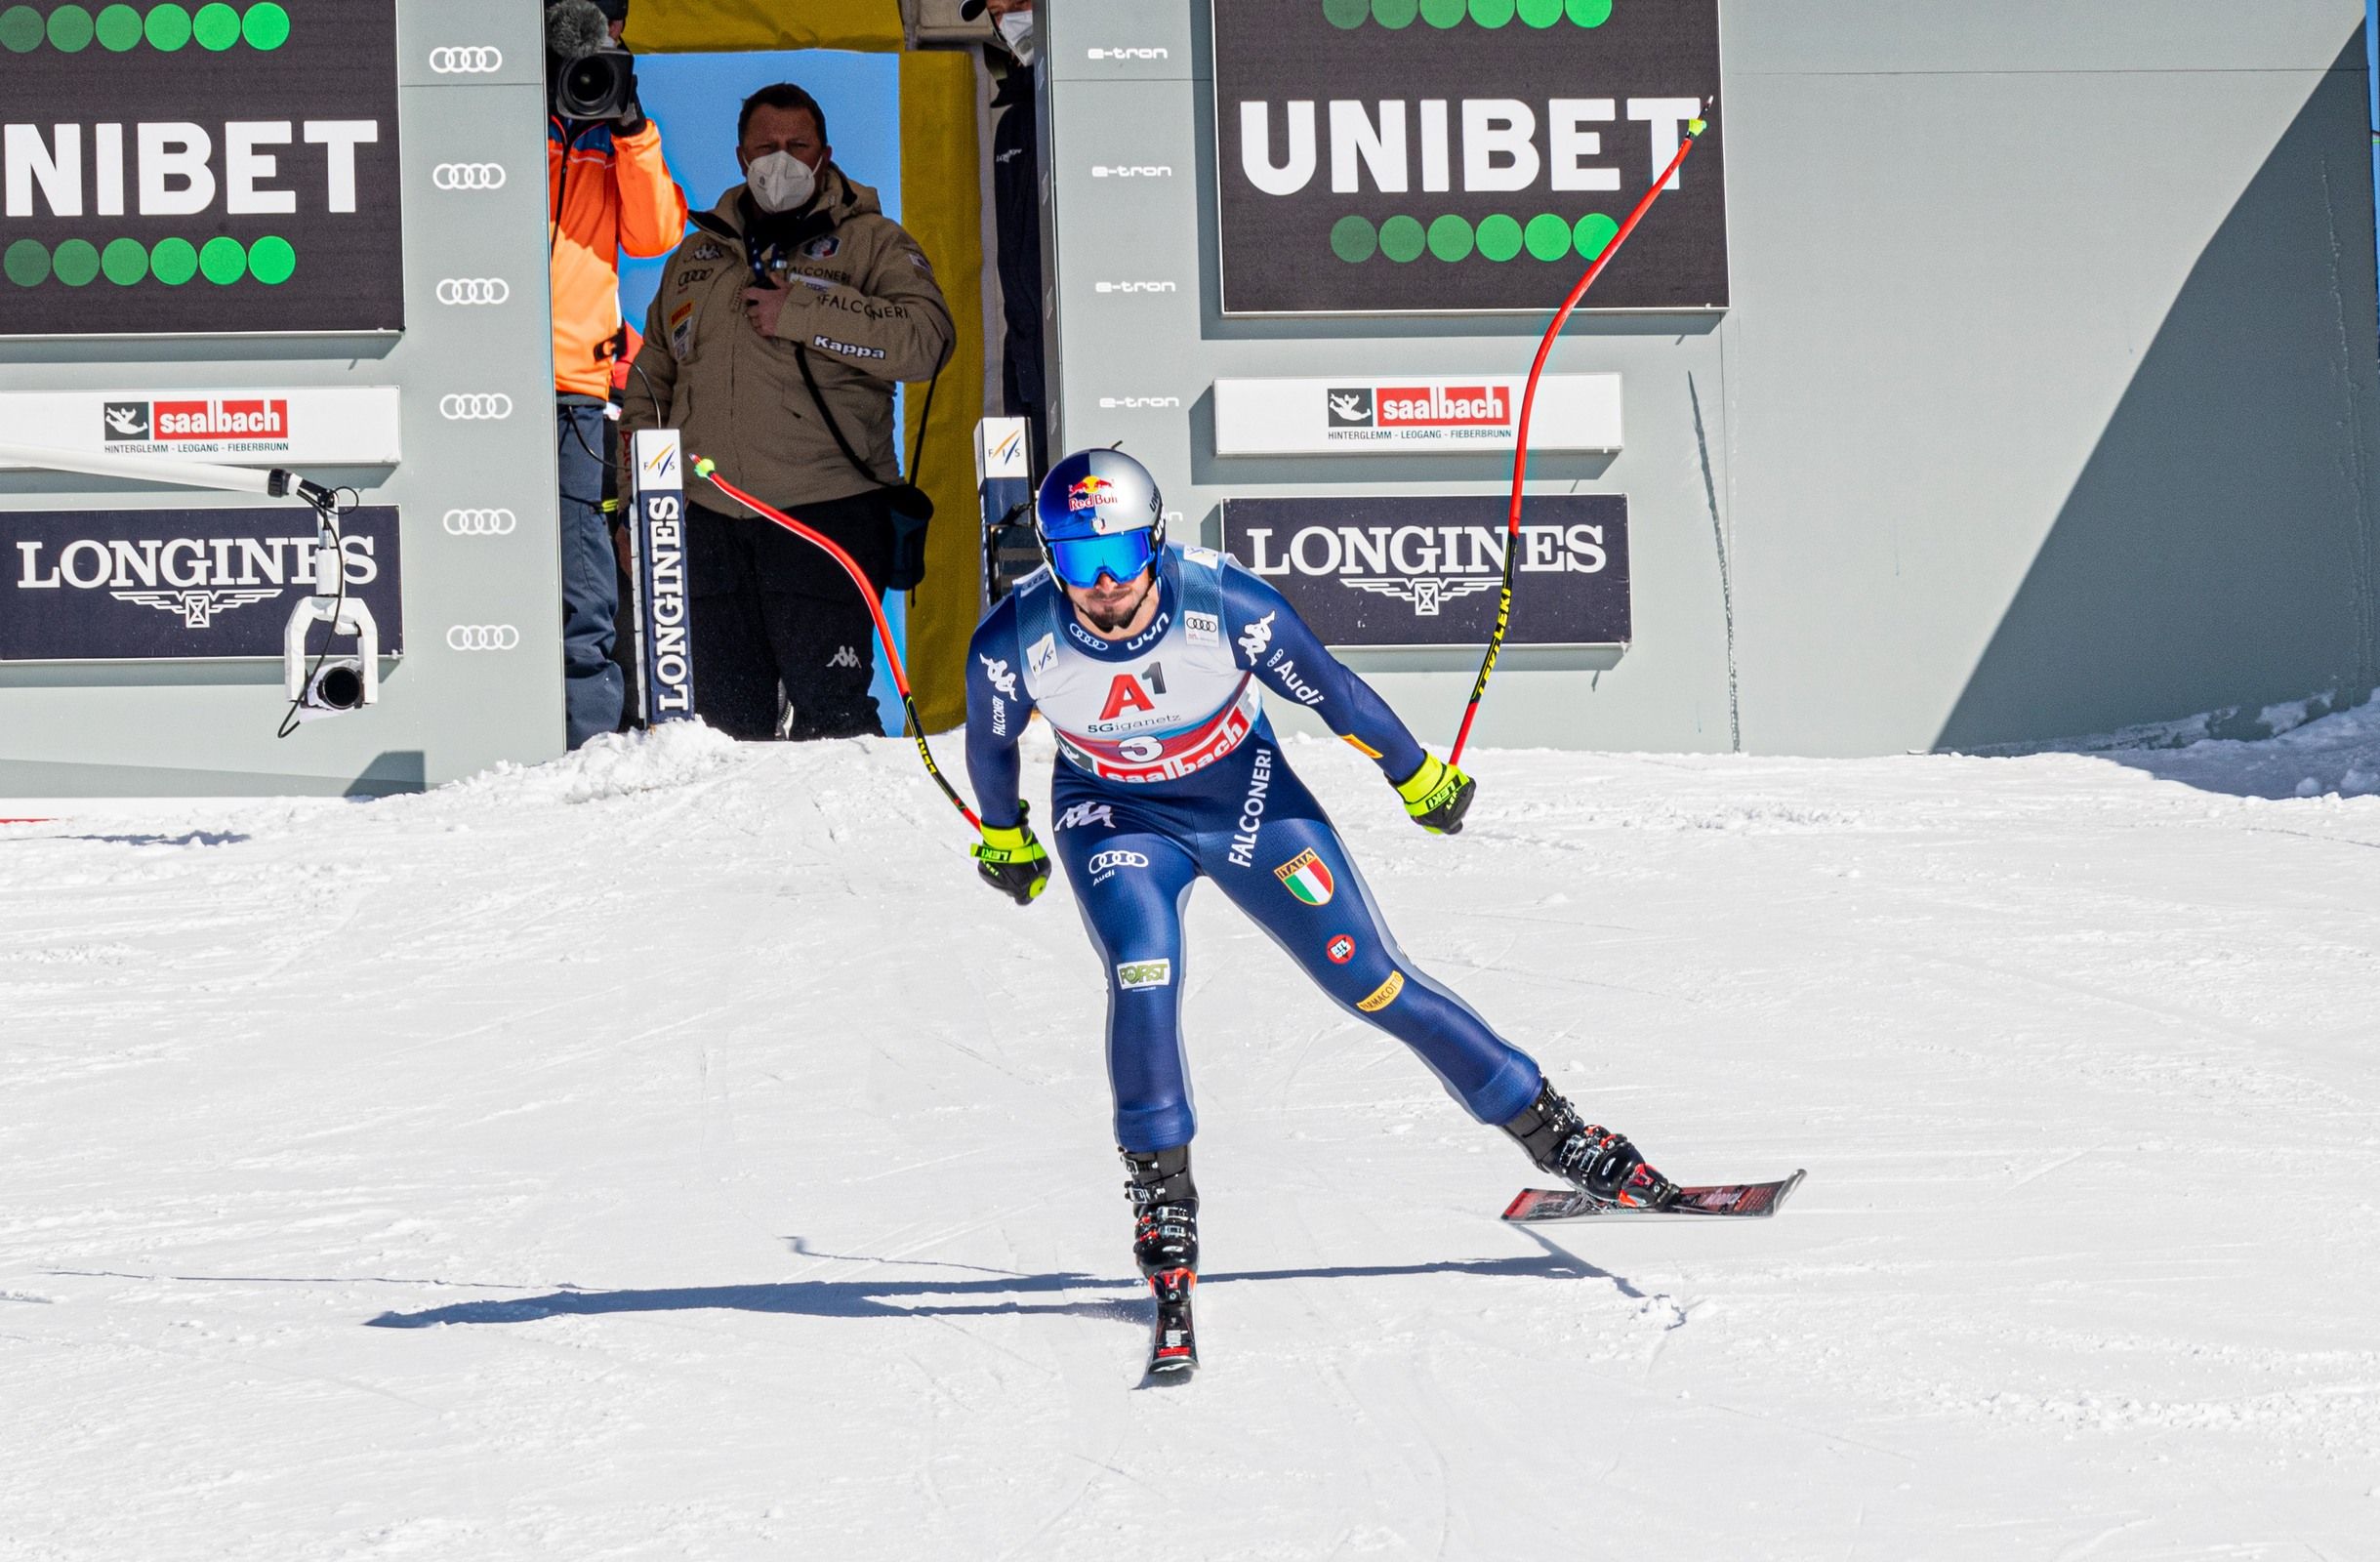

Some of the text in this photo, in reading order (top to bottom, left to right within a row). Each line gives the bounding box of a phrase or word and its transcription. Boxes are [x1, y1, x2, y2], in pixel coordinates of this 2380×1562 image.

[1088, 48, 1168, 59] e-tron
[1241, 98, 1701, 196] UNIBET
[4, 120, 378, 217] NIBET
[1092, 166, 1171, 177] e-tron
[1095, 281, 1175, 292] e-tron
[821, 294, 909, 320] FALCONERI
[813, 335, 886, 359] Kappa
[1099, 397, 1179, 407] e-tron
[1383, 387, 1503, 421] saalbach
[159, 400, 281, 434] saalbach
[104, 441, 289, 454] HINTERGLEMM LEOGANG FIEBERBRUNN
[1328, 429, 1512, 440] HINTERGLEMM LEOGANG FIEBERBRUNN
[1068, 494, 1094, 512] Red
[17, 536, 378, 589] LONGINES
[1247, 524, 1608, 575] LONGINES
[648, 495, 689, 711] LONGINES
[1494, 588, 1511, 640] LEKI
[1098, 661, 1168, 720] A1
[1274, 660, 1324, 706] Audi
[1427, 780, 1456, 808] LEKI
[1227, 749, 1272, 868] FALCONERI
[981, 847, 1009, 861] LEKI
[1276, 849, 1316, 879] ITALIA
[1093, 869, 1115, 886] Audi
[1119, 964, 1169, 985] FORST
